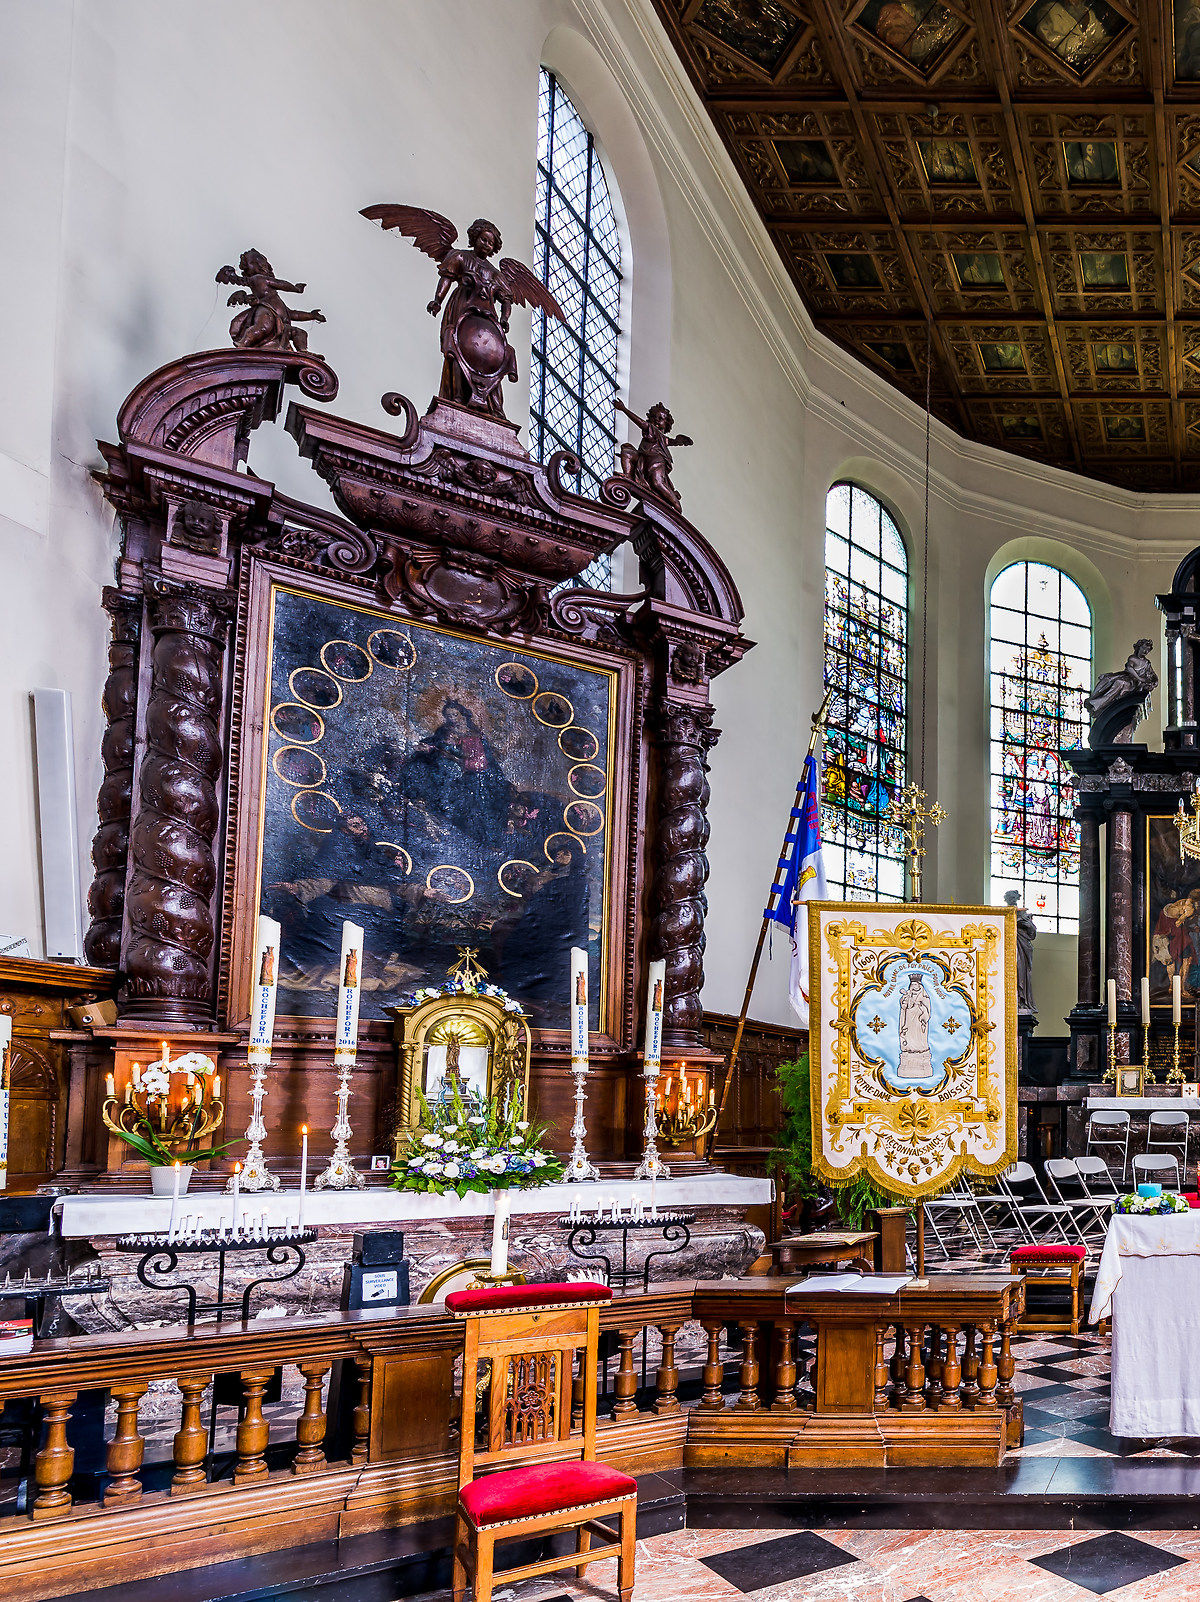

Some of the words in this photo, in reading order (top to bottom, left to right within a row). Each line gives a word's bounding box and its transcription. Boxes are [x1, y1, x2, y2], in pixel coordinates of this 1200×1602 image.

[858, 954, 875, 968] 1609
[258, 986, 269, 1037] ROCHEFORT
[344, 988, 353, 1037] ROCHEFORT
[851, 1060, 861, 1073] FOY
[937, 1063, 977, 1102] BOISSEILLES
[885, 1135, 944, 1156] RECONNAISSANCE
